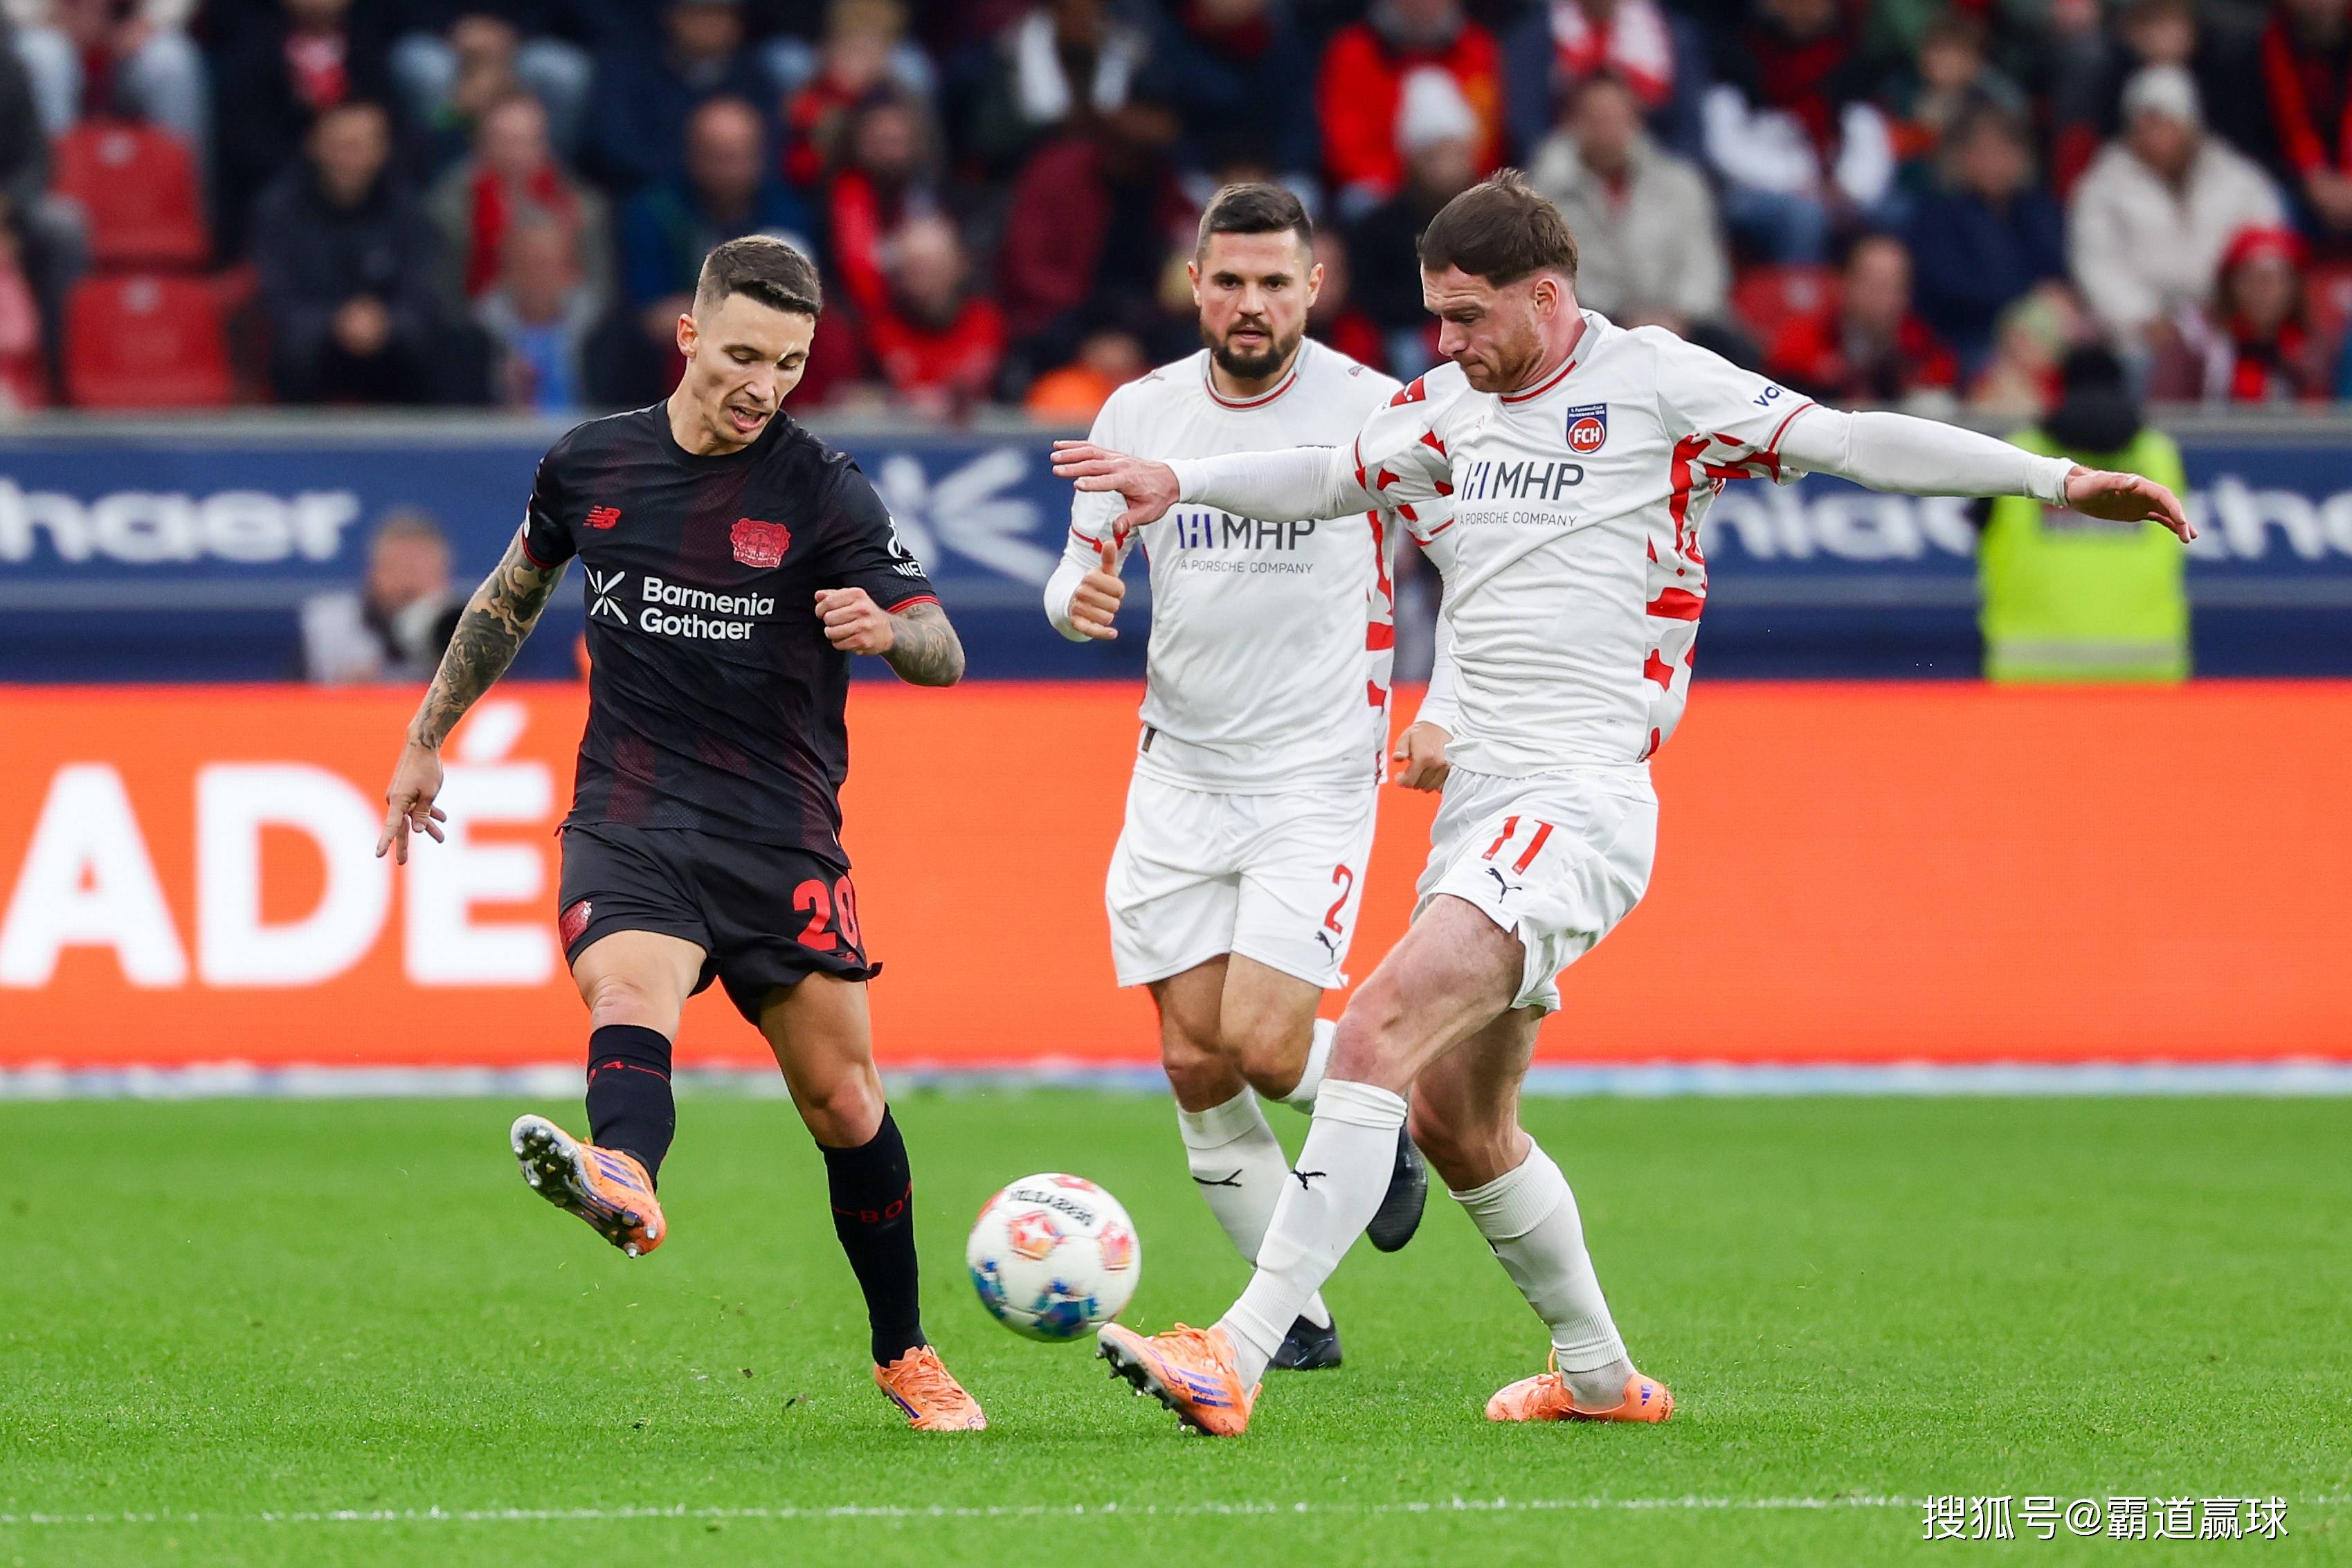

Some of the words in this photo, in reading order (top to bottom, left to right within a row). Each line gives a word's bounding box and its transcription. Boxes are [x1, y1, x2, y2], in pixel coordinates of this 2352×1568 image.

[1573, 426, 1600, 444] FCH
[1491, 461, 1584, 501] MHP
[1222, 513, 1316, 550] MHP
[1460, 514, 1465, 526] A
[1465, 511, 1510, 525] PORSCHE
[1512, 511, 1577, 527] COMPANY
[1180, 559, 1188, 569] A
[1191, 560, 1245, 573] PORSCHE
[1249, 561, 1314, 574] COMPANY
[642, 576, 775, 617] Barmenia
[640, 606, 755, 640] Gothaer
[0, 700, 554, 990] ADÉ
[1481, 815, 1555, 875] 11
[793, 875, 859, 951] 20
[1324, 864, 1354, 935] 2
